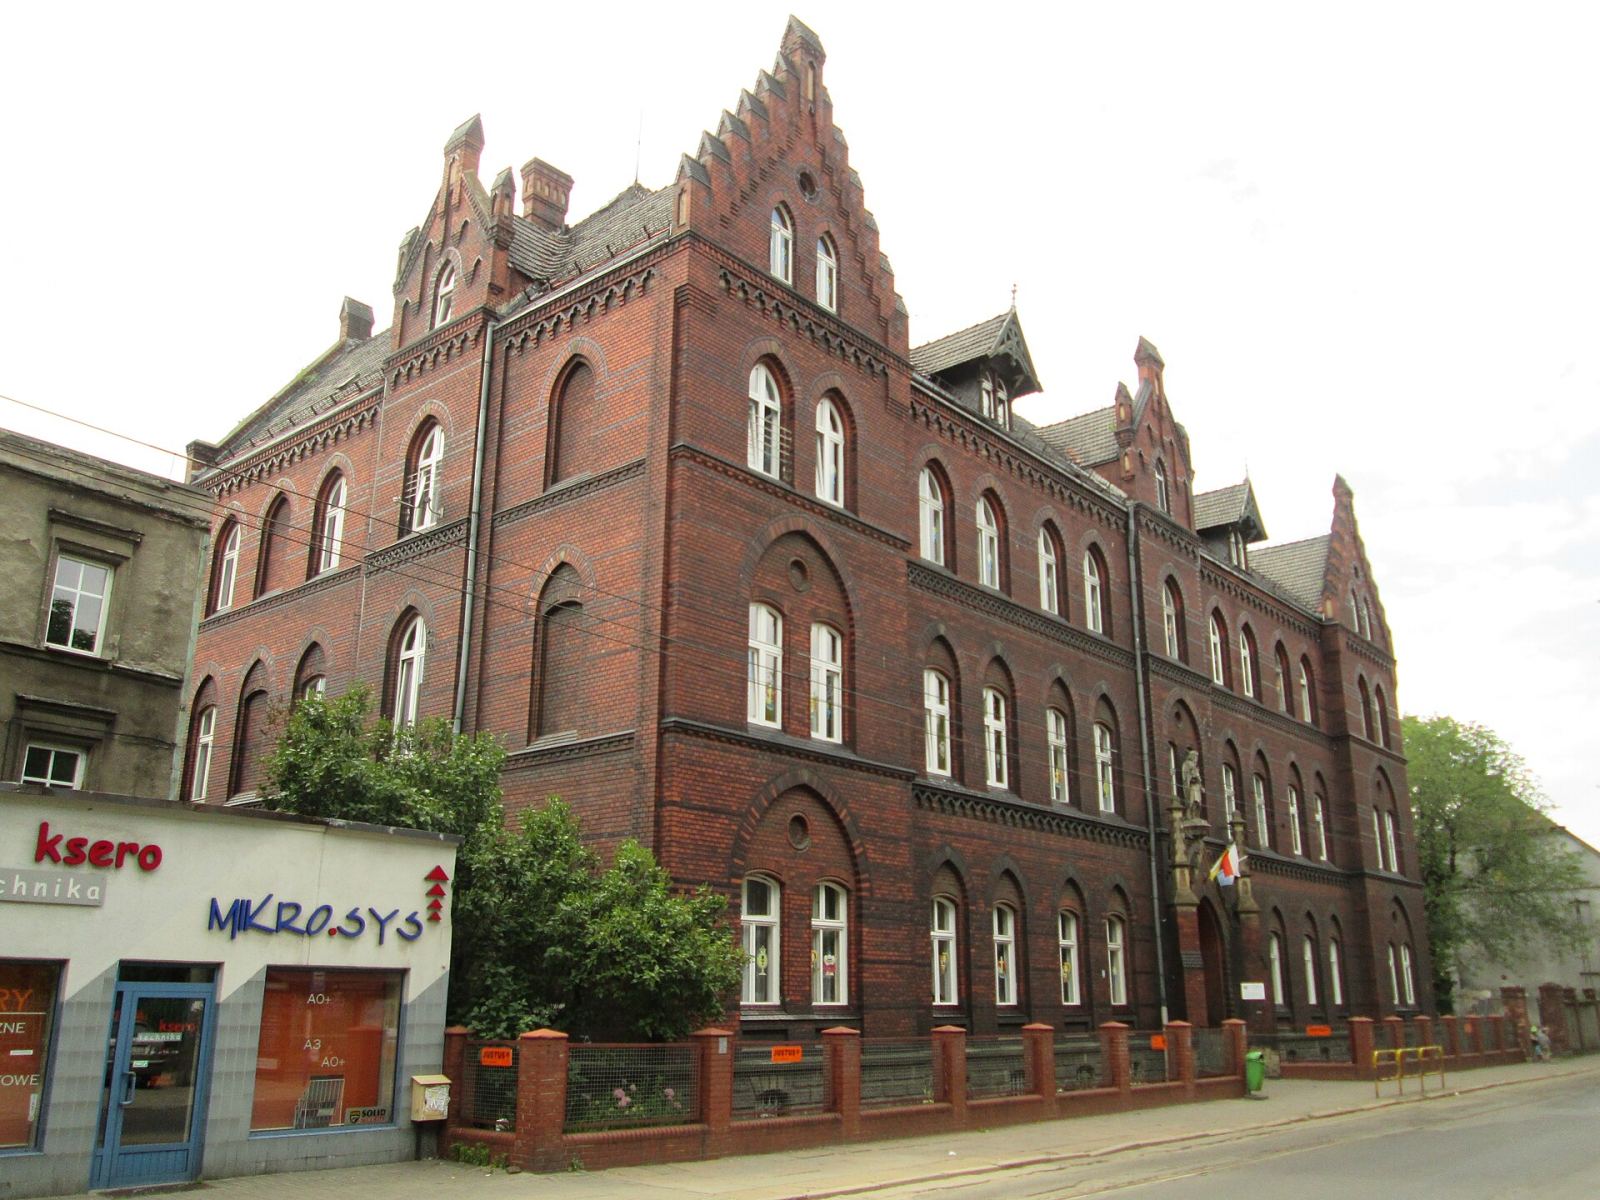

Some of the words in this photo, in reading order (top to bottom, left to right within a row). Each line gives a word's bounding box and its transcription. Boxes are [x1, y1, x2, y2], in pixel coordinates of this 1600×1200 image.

[34, 821, 163, 872] ksero
[208, 893, 424, 946] MIKRO.SYS
[303, 1039, 322, 1050] A3
[0, 1074, 40, 1086] OWE
